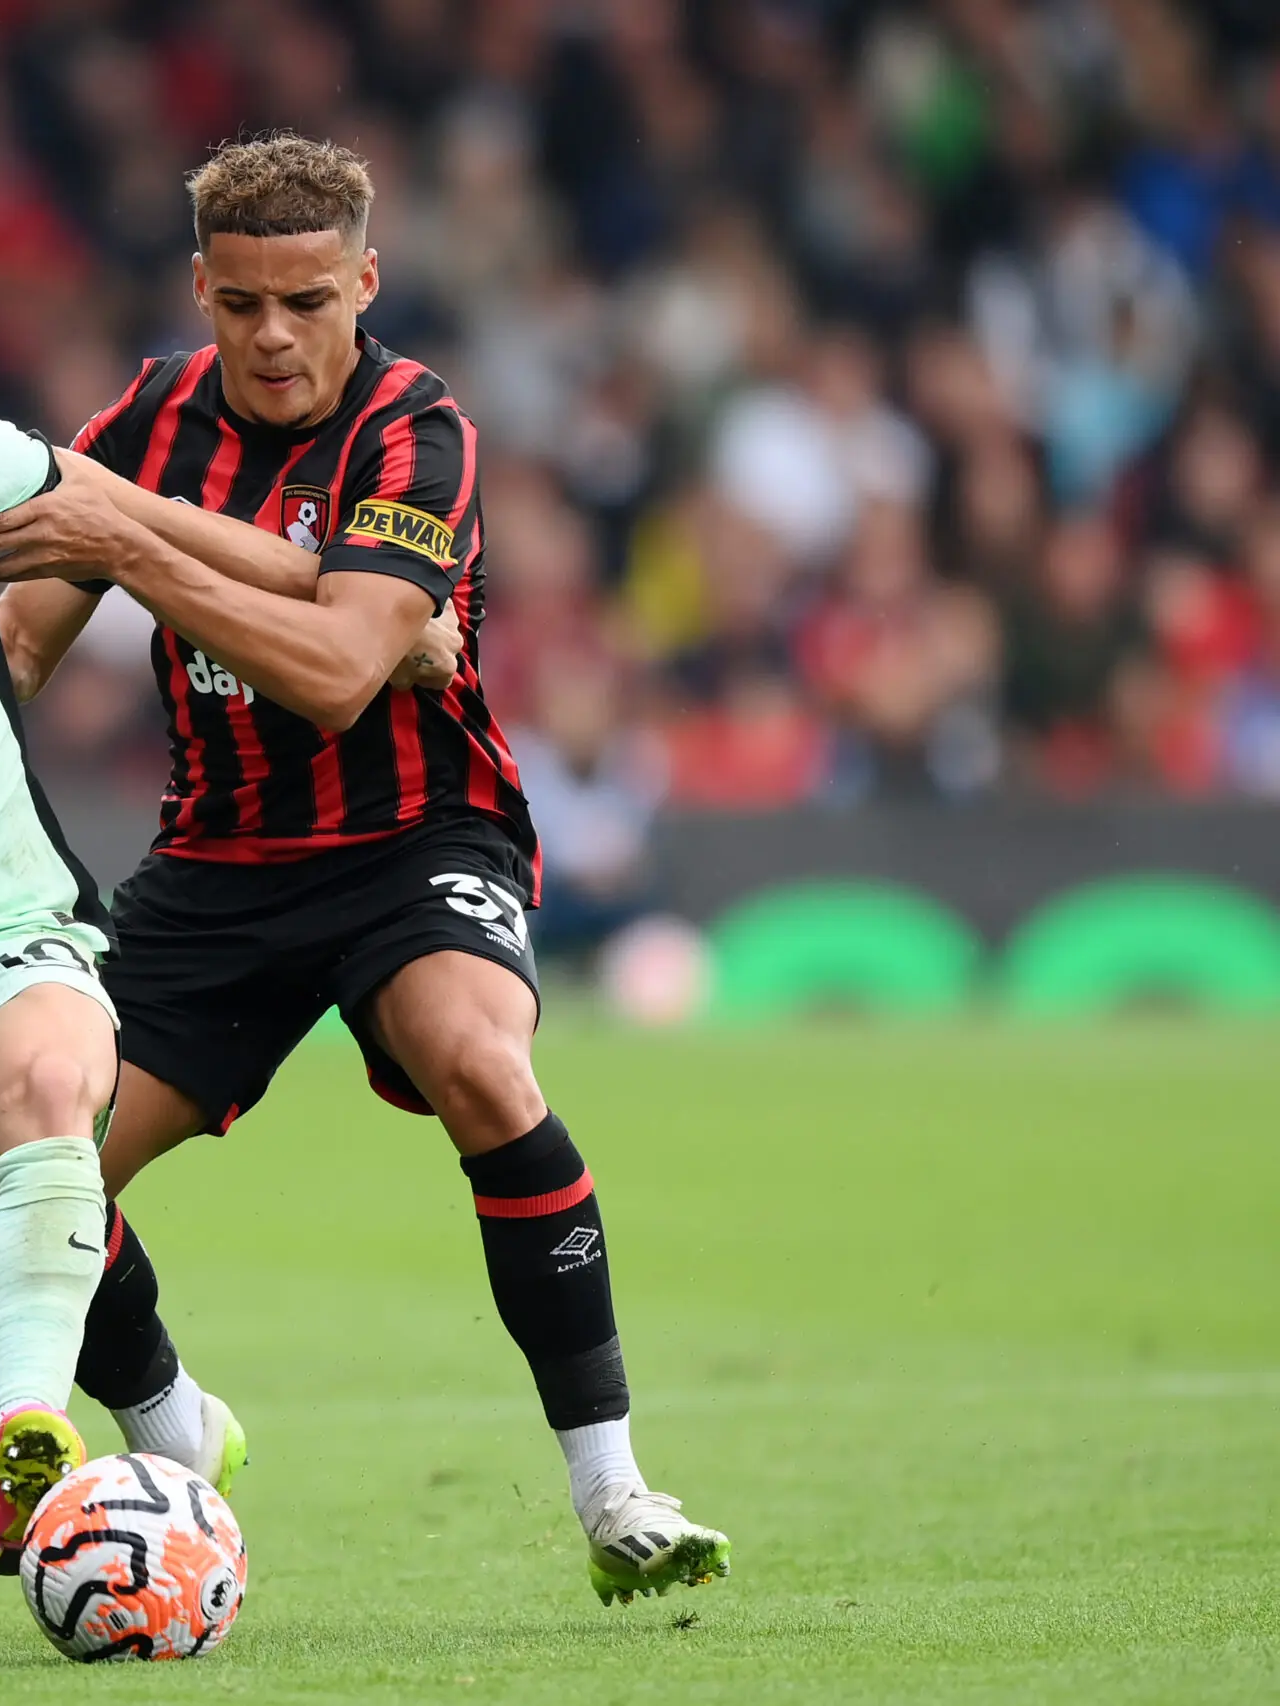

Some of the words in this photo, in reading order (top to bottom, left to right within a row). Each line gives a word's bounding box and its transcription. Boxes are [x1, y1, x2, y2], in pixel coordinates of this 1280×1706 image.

[428, 872, 527, 951] 37
[486, 931, 521, 957] umbro
[557, 1249, 602, 1273] umbro
